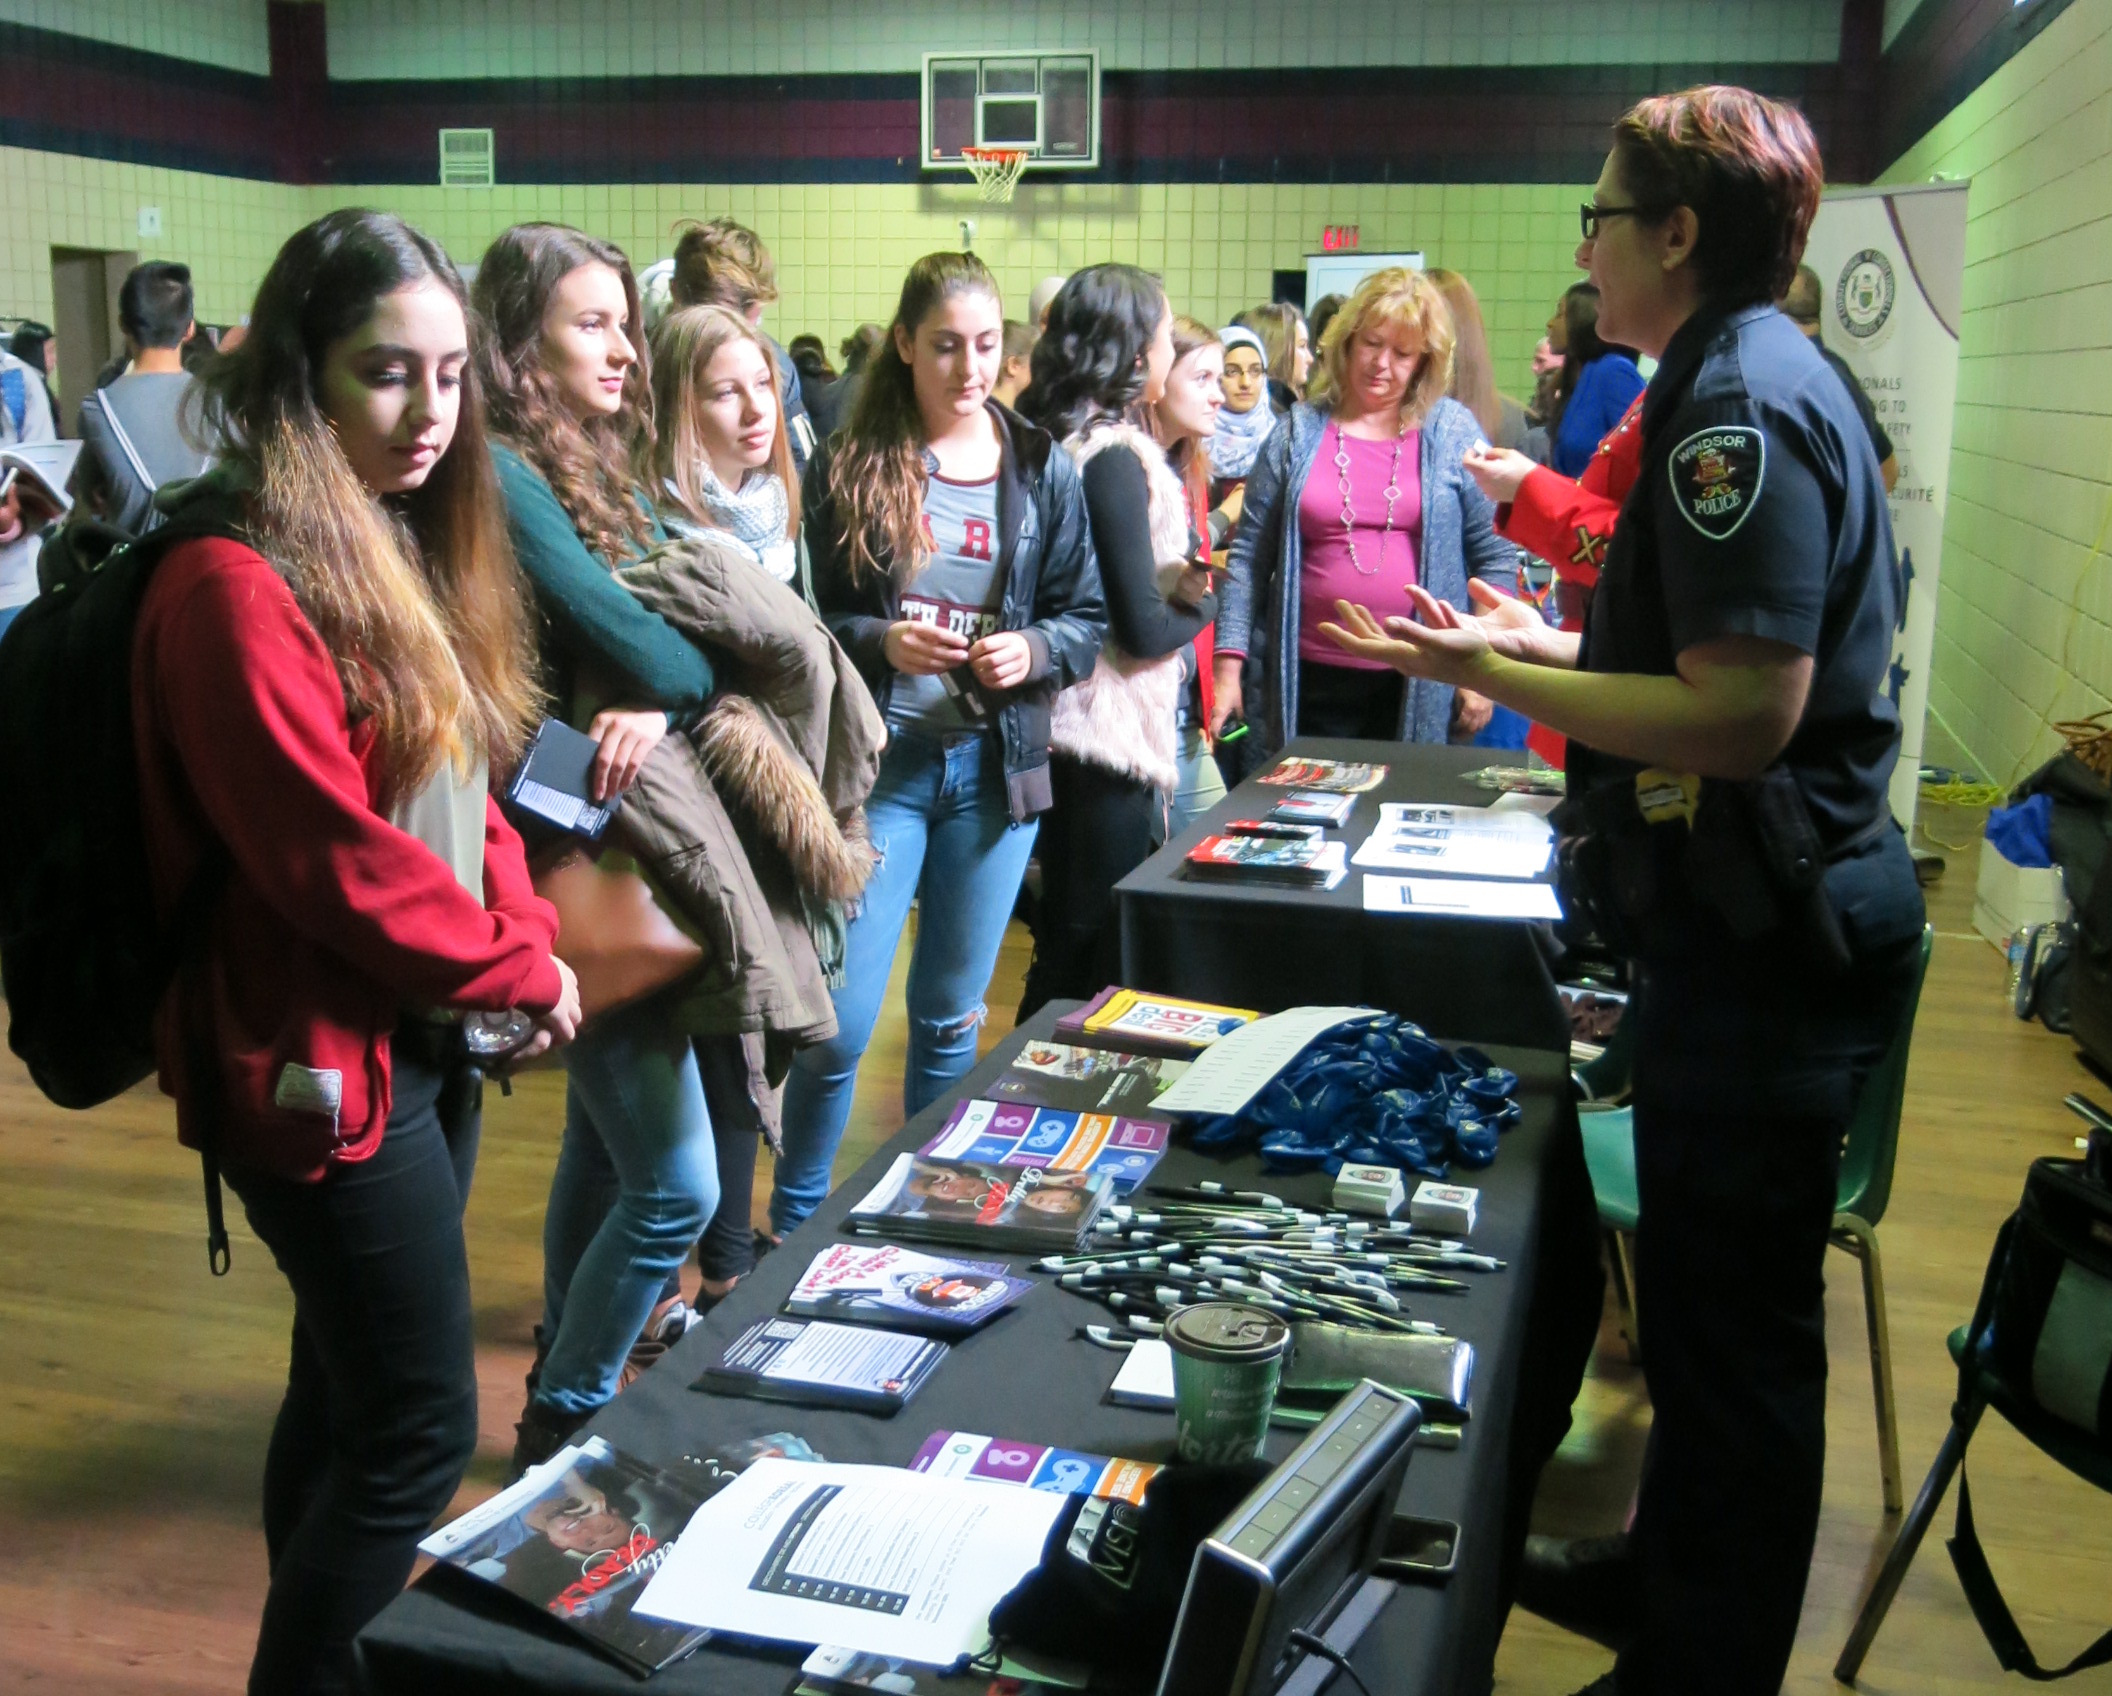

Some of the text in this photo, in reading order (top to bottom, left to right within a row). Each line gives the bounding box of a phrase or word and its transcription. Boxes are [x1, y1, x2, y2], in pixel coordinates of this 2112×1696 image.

[1323, 224, 1360, 250] EXIT
[1677, 435, 1746, 463] WINDSOR
[1693, 488, 1741, 515] POLICE
